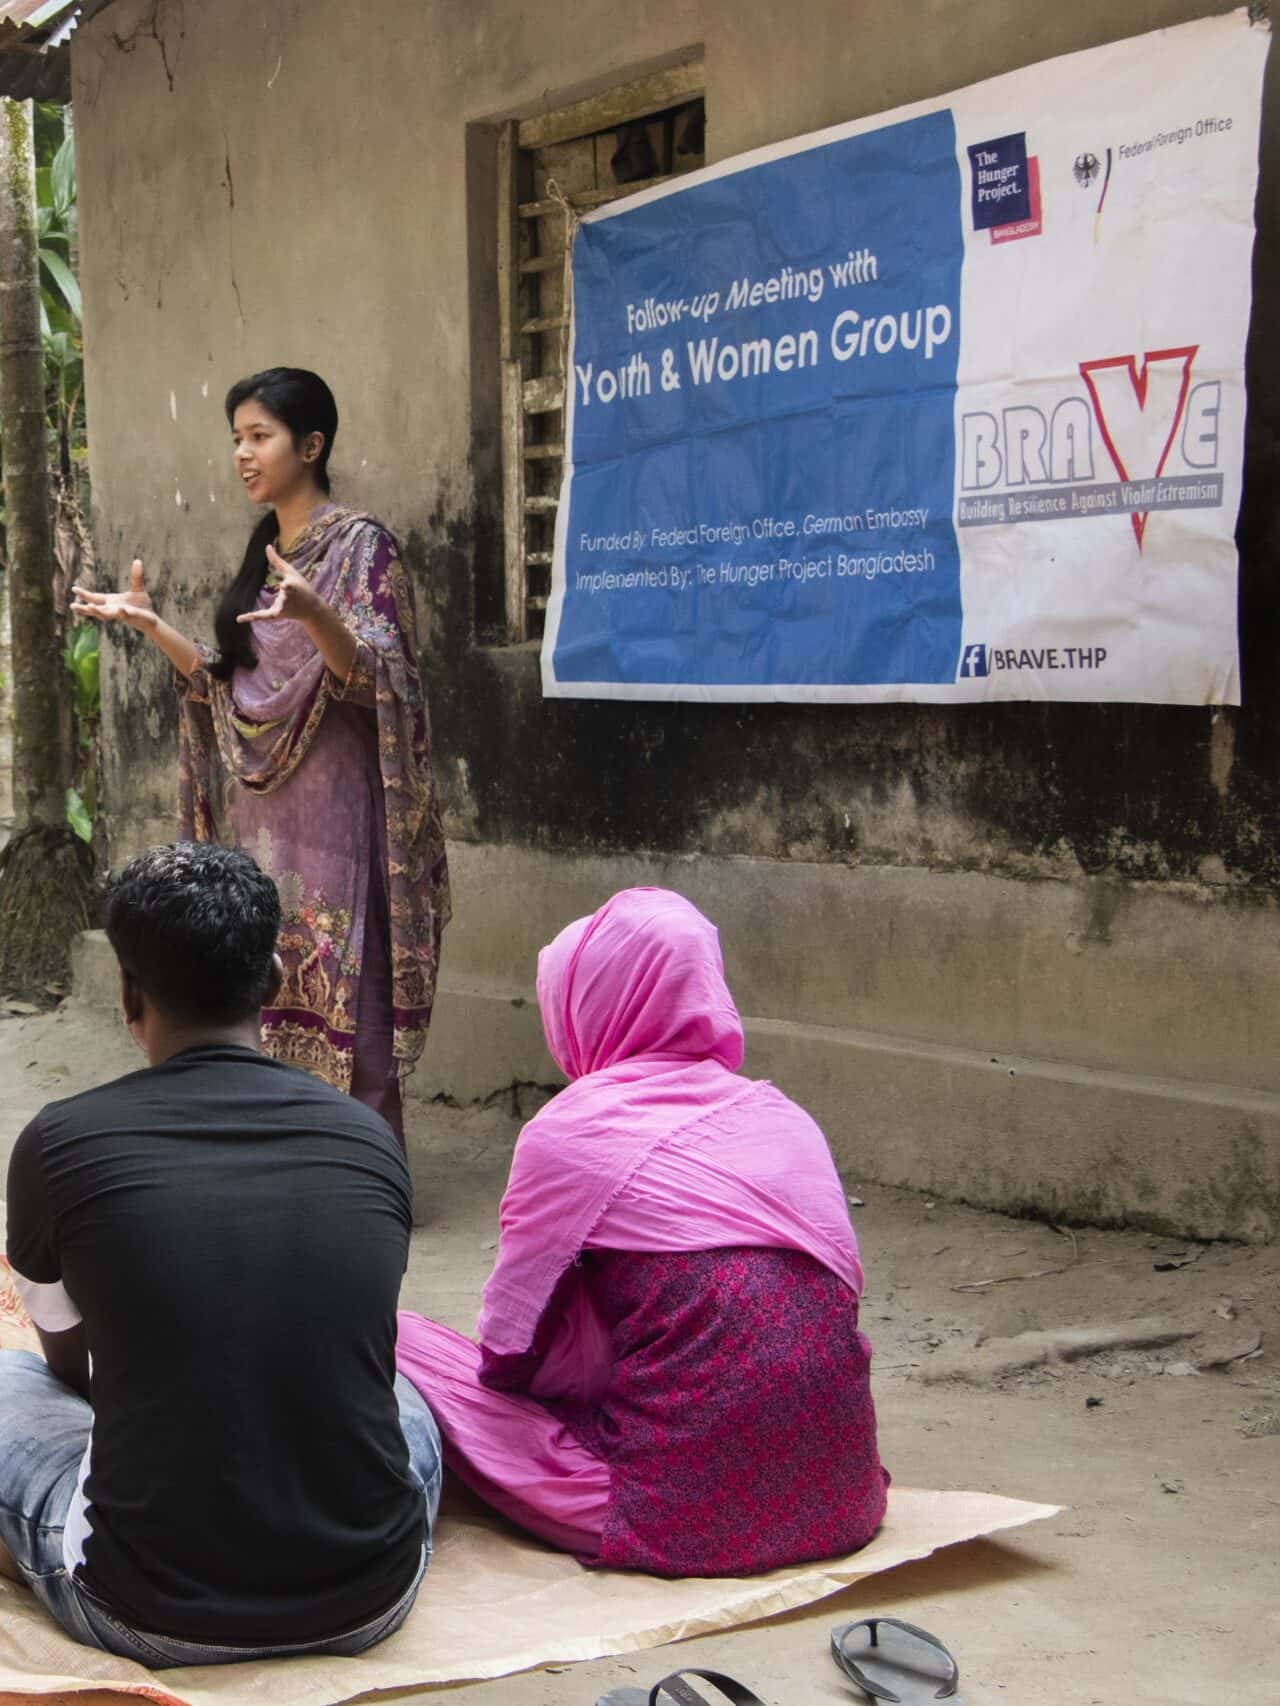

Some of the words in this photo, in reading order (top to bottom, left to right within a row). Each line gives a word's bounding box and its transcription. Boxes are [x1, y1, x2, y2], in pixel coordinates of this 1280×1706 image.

[1195, 118, 1233, 136] Office
[976, 151, 998, 167] The
[977, 164, 1020, 184] Hunger
[626, 291, 720, 334] Follow-up
[724, 266, 824, 311] Meeting
[828, 248, 878, 289] with
[661, 348, 681, 392] &
[687, 329, 818, 386] Women
[830, 304, 952, 361] Group
[961, 345, 1221, 557] BRAVE
[960, 499, 1005, 521] Building
[1008, 495, 1067, 516] Resilience
[1072, 489, 1117, 514] Against
[580, 529, 631, 551] Funded
[699, 521, 751, 545] Foreign
[803, 514, 864, 535] German
[865, 507, 929, 529] Embassy
[671, 566, 693, 591] By:
[721, 562, 775, 587] Hunger
[779, 555, 832, 583] Project
[837, 547, 935, 580] Bangladesh
